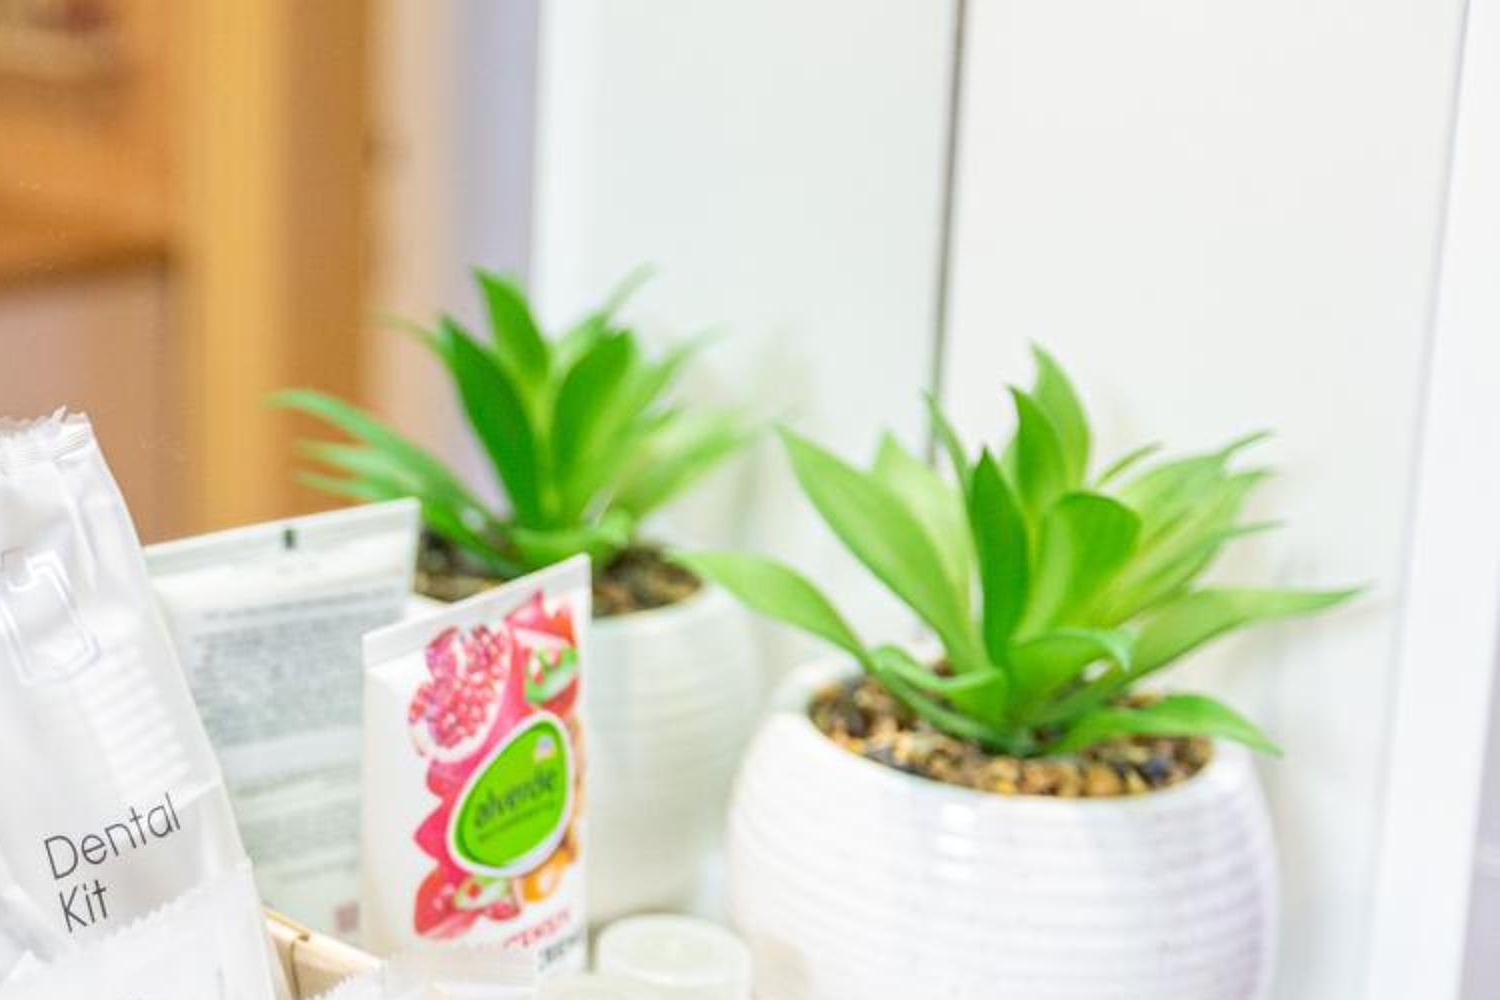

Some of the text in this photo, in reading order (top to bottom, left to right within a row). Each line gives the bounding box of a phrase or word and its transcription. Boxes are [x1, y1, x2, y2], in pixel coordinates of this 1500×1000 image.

[474, 765, 557, 829] alverde
[44, 792, 181, 879] Dental
[59, 879, 107, 933] Kit
